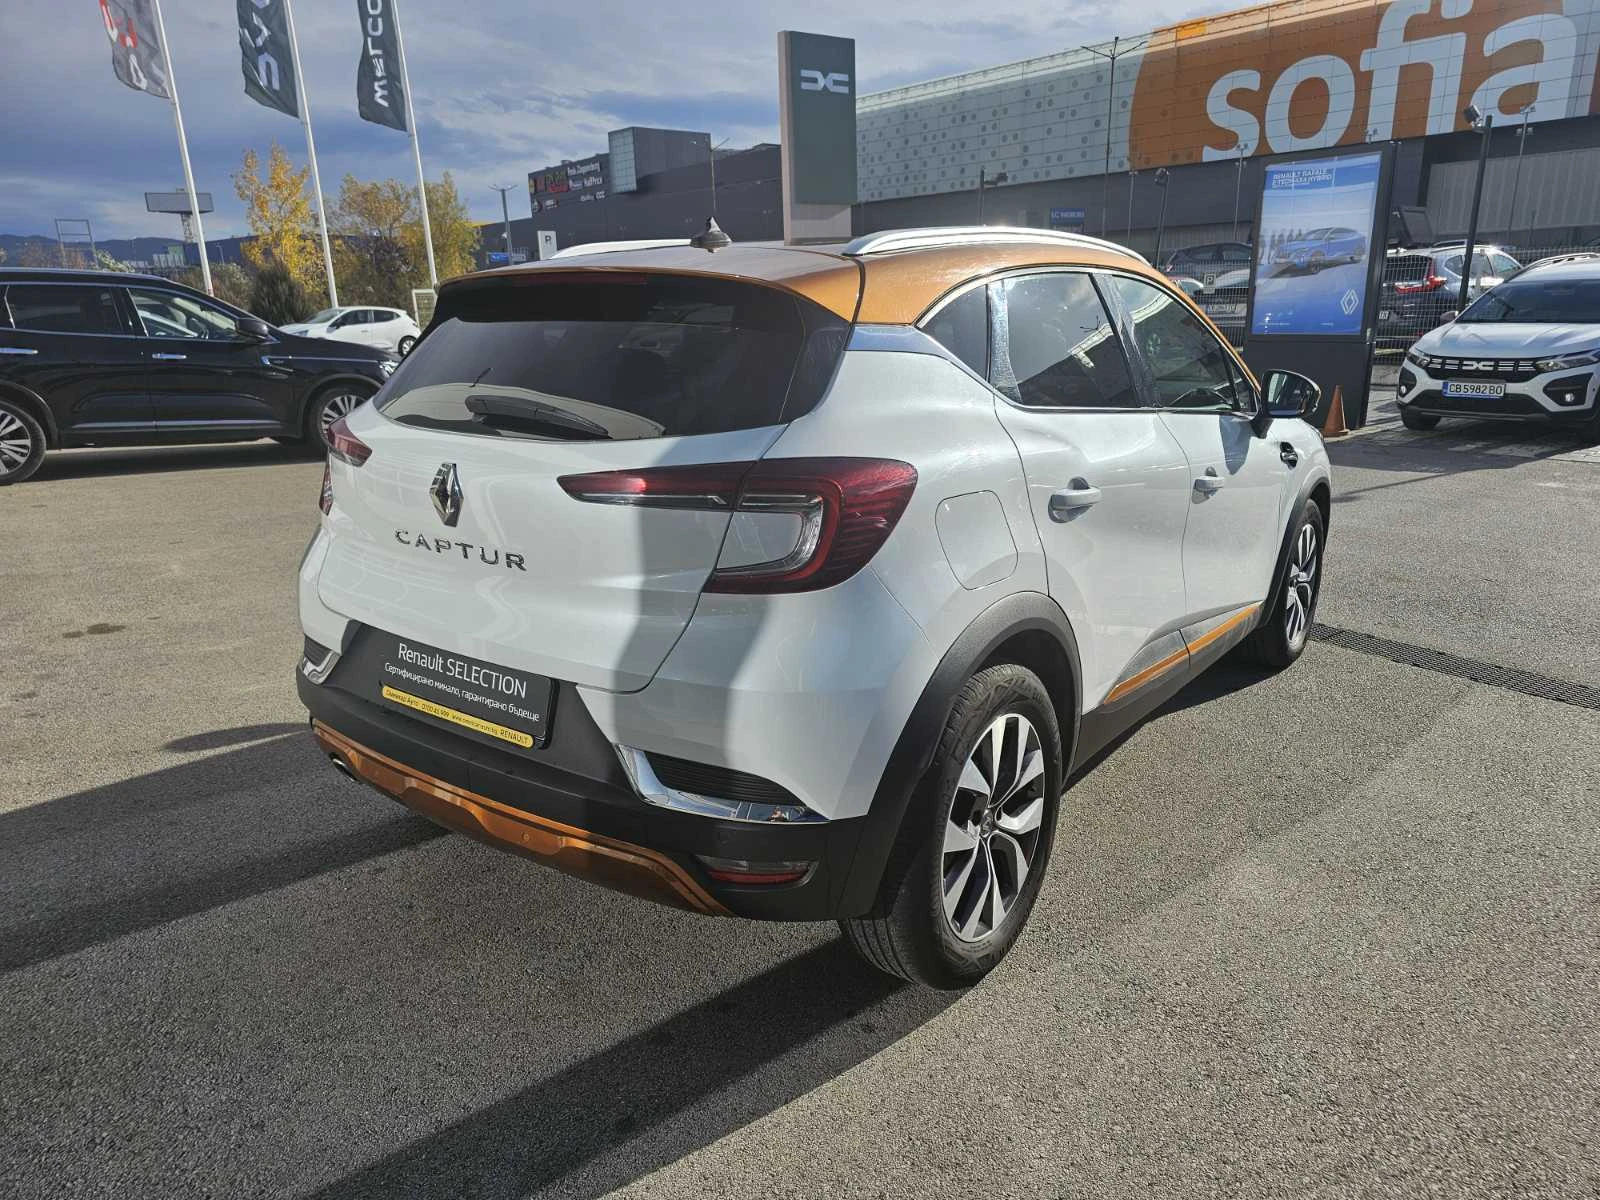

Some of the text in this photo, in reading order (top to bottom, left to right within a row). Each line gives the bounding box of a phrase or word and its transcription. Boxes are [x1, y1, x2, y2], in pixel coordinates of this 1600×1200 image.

[1202, 0, 1577, 162] sofia
[395, 530, 527, 572] CAPTUR
[384, 662, 540, 722] Сертифицирано минало, гарантирано бъдеще
[398, 642, 527, 699] Renault SELECTION
[499, 729, 530, 744] RENAULT
